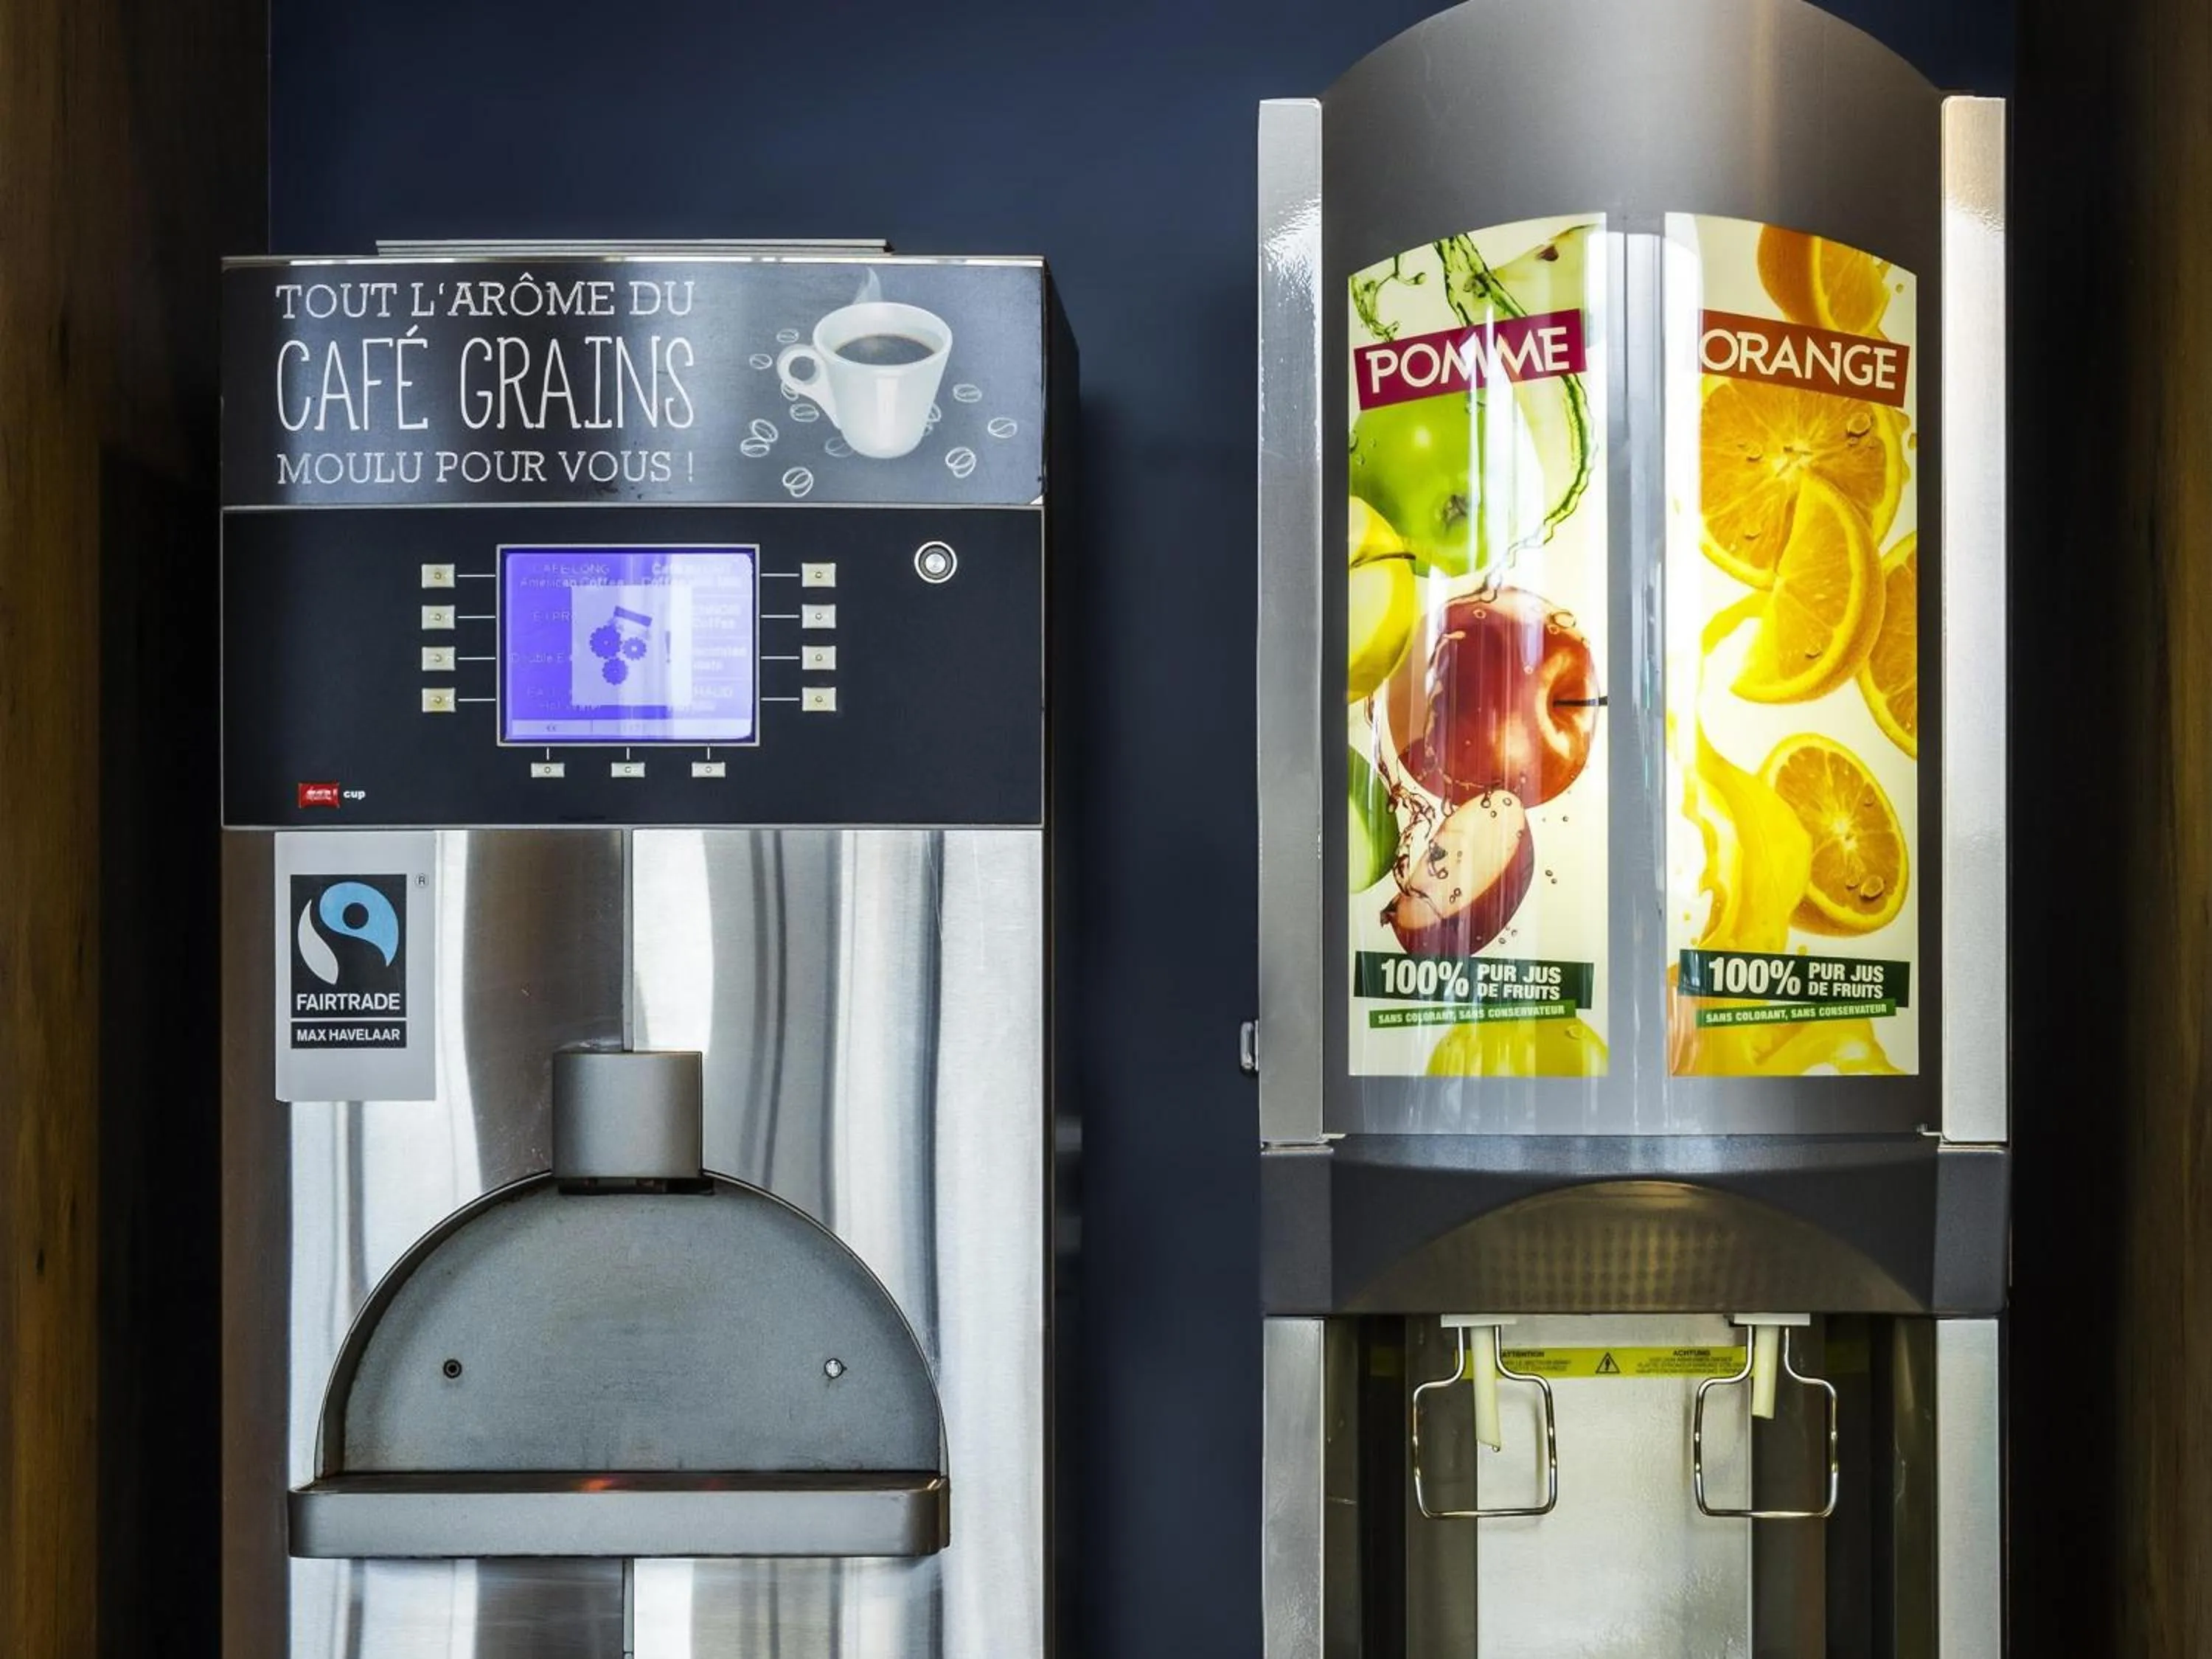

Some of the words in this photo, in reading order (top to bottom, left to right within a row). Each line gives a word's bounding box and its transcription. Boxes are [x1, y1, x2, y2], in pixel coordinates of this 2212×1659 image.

[276, 282, 397, 319] TOUT
[629, 281, 694, 316] DU
[1365, 327, 1570, 393] POMME
[1699, 328, 1897, 390] ORANGE
[276, 324, 428, 431] CAFÉ
[460, 335, 695, 429] GRAINS
[276, 453, 423, 484] MOULU
[435, 451, 546, 482] POUR
[558, 451, 672, 481] VOUS
[343, 790, 366, 800] cup
[1381, 959, 1470, 997] 100%
[1477, 963, 1517, 982] PUR
[1523, 966, 1562, 984] JUS
[1708, 957, 1801, 995] 100%
[1808, 961, 1845, 981] PUR
[1850, 964, 1885, 983] JUS
[296, 992, 400, 1011] FAIRTRADE
[1477, 983, 1500, 998] DE
[1503, 984, 1561, 1001] FRUITS
[1808, 982, 1829, 996] DE
[1832, 983, 1884, 998] FRUITS
[1378, 1014, 1403, 1024] SANS
[1405, 1011, 1457, 1023] COLORANT,
[1458, 1008, 1486, 1020] SANS
[1487, 1005, 1565, 1019] CONSERVATEUR
[1705, 1012, 1733, 1023] SANS
[1735, 1009, 1789, 1021] COLORANT,
[1790, 1007, 1817, 1018] SANS
[1818, 1003, 1888, 1017] CONSERVATEUR
[296, 1029, 327, 1041] MAX
[328, 1028, 400, 1041] HAVELAAR
